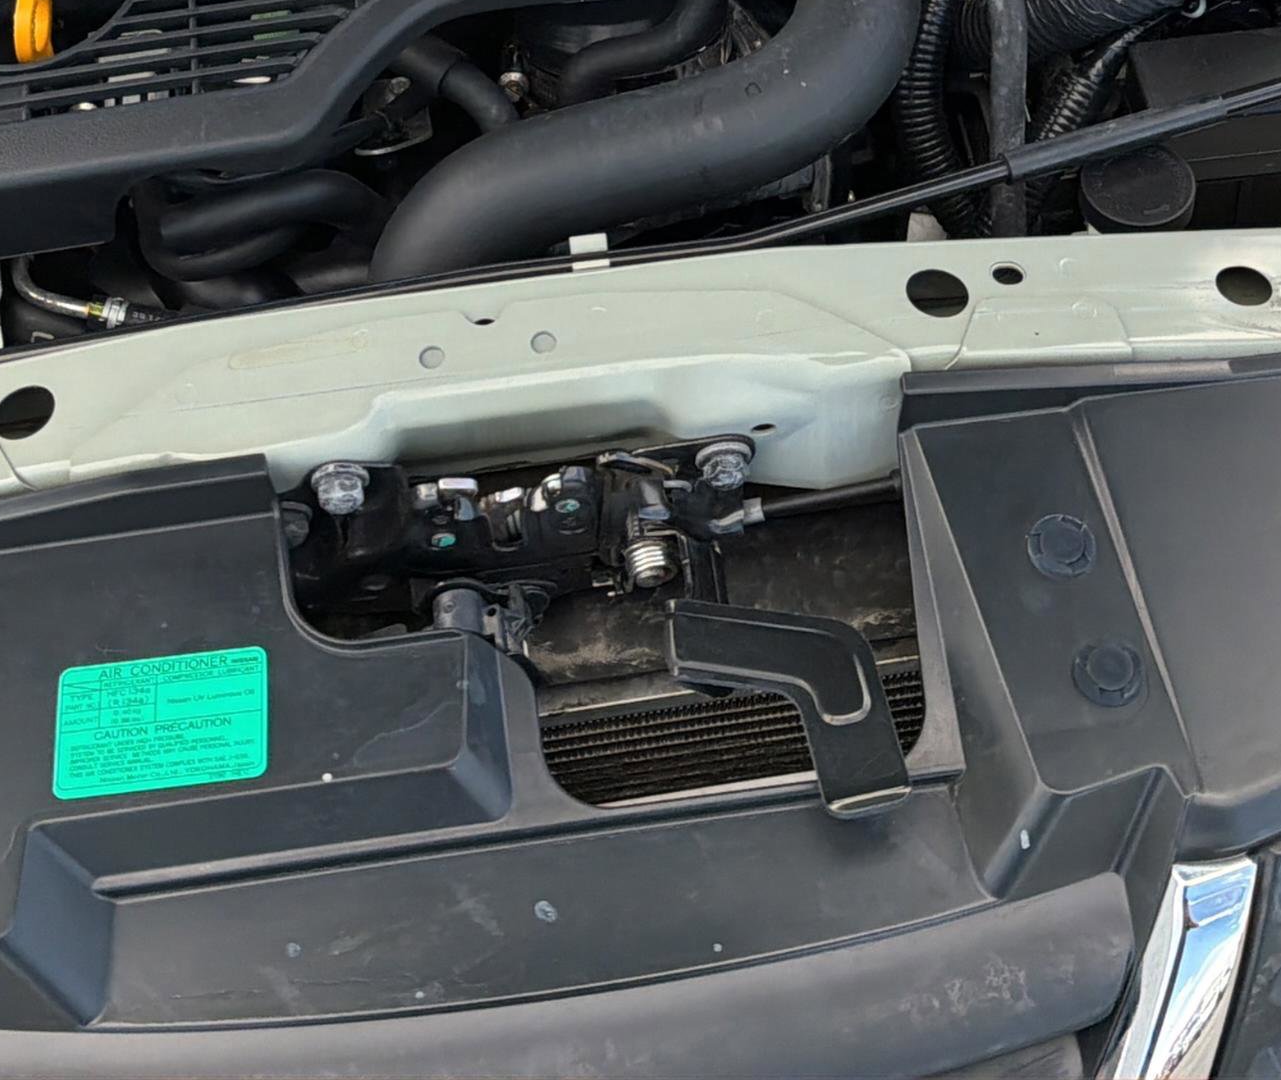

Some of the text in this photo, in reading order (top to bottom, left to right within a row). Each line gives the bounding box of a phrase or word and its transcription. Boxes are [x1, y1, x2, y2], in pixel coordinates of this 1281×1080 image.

[99, 666, 122, 679] AIR
[130, 655, 228, 677] CONDITIONER
[69, 693, 93, 702] TYPE
[94, 717, 232, 740] CAUTION PRECAUTION
